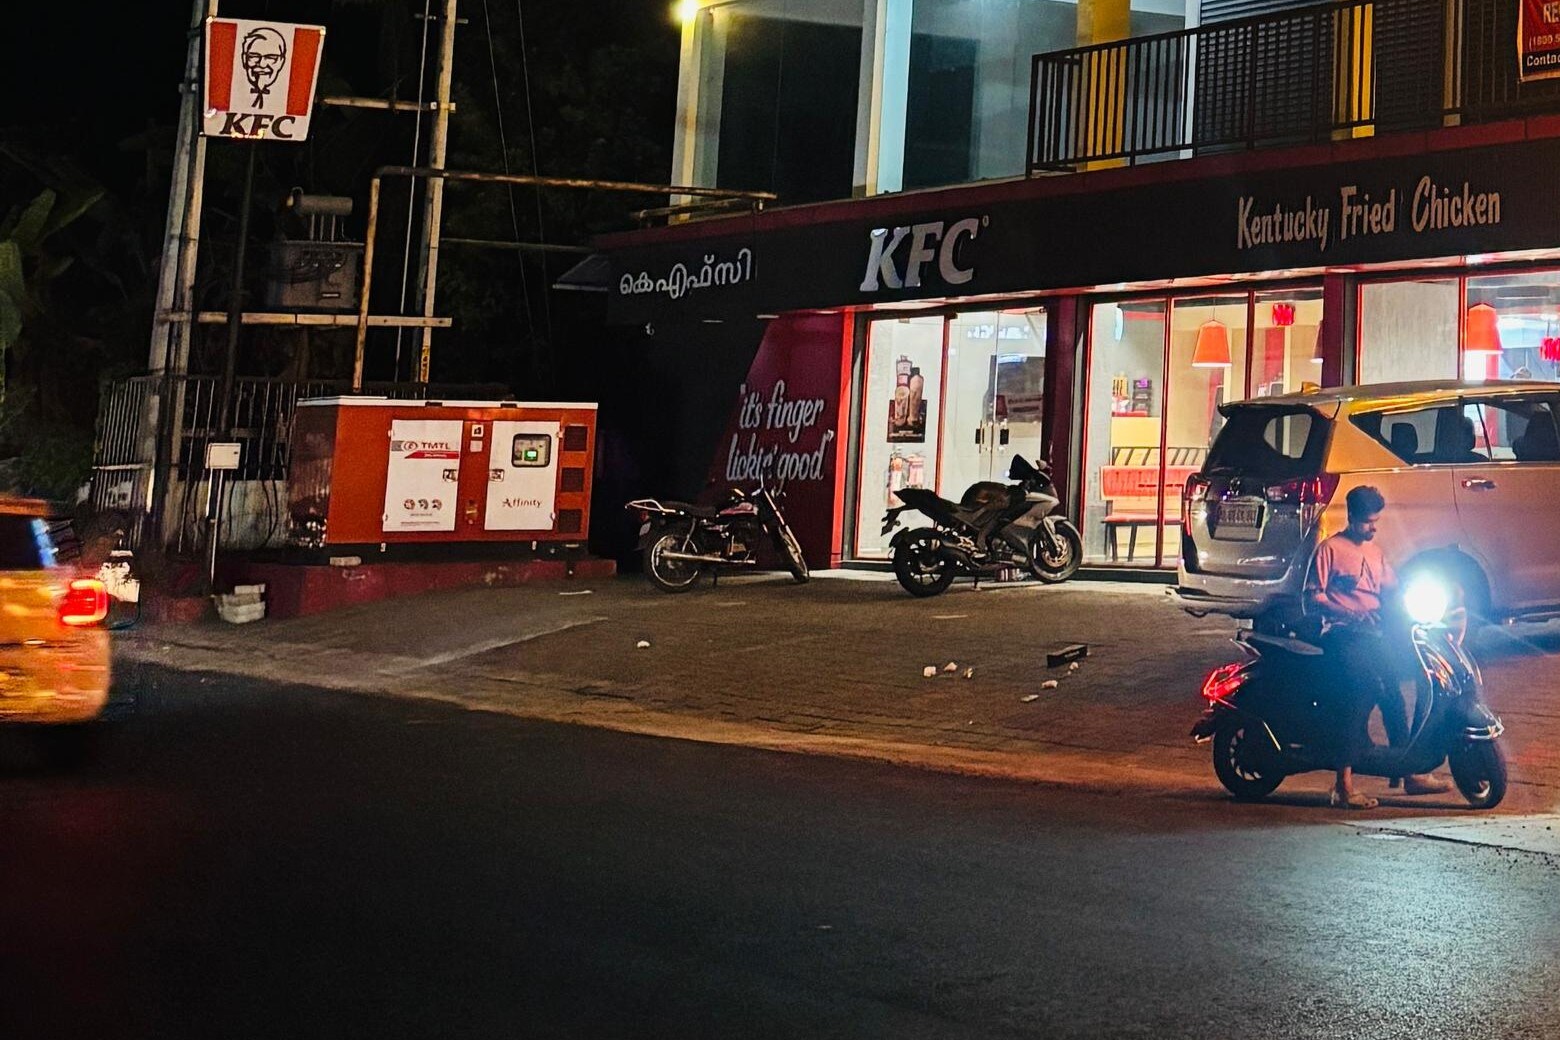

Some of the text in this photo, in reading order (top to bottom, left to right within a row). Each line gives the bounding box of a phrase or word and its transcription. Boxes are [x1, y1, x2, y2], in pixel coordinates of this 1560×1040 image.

[219, 112, 296, 139] KFC
[1237, 175, 1500, 252] Kentucky Fried Chicken
[859, 218, 979, 292] KFC
[766, 379, 825, 444] finger
[420, 442, 451, 450] TMTL
[502, 498, 543, 508] Affinity
